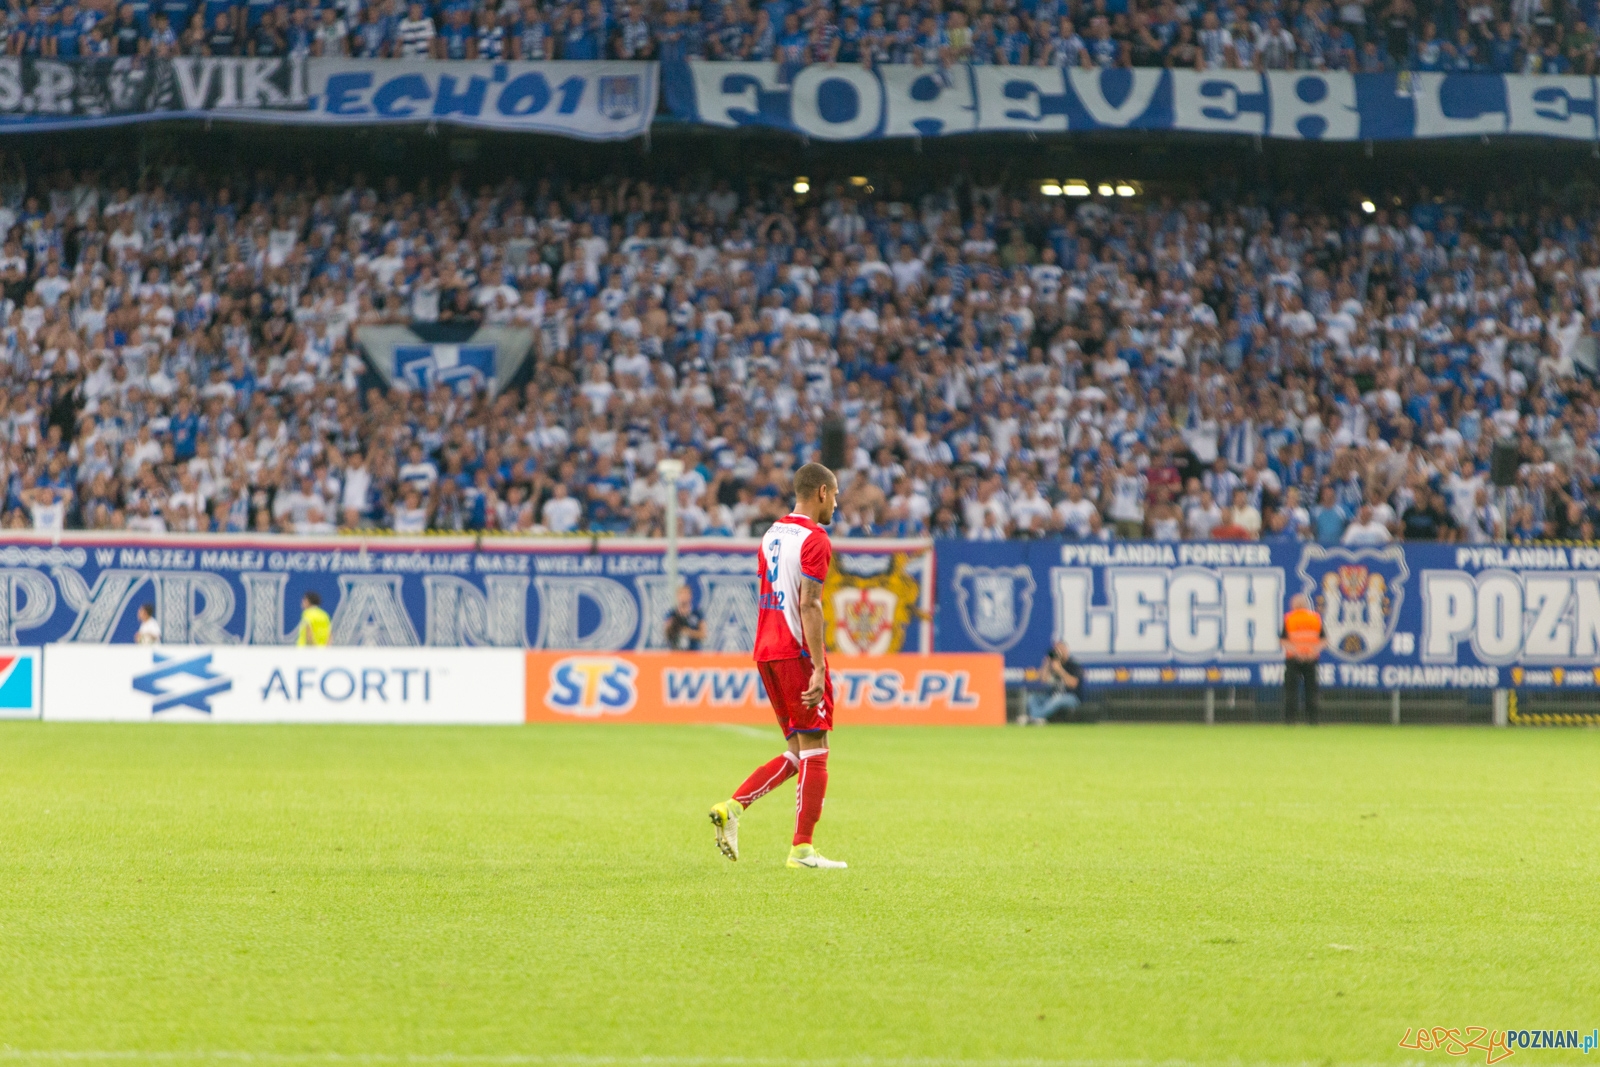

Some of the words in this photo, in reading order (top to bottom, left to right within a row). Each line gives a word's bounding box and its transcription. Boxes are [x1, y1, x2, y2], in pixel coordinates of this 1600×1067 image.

[307, 64, 587, 117] ECH'01
[690, 60, 1360, 141] FOREVER
[1412, 72, 1600, 140] LE
[95, 548, 116, 568] W
[119, 549, 196, 570] NASZEJ
[606, 555, 660, 576] LECH
[766, 539, 781, 583] 3
[1060, 543, 1177, 566] PYRLANDIA
[1178, 544, 1272, 566] FOREVER
[1455, 547, 1570, 569] PYRLANDIA
[1570, 547, 1600, 569] FO
[0, 567, 760, 650] PYRLANDIA
[1050, 565, 1286, 664] LECH
[262, 668, 431, 703] AFORTI
[545, 656, 638, 715] STS
[664, 669, 980, 708] WWTS.PL
[1339, 664, 1379, 686] THE
[1382, 664, 1500, 687] CHAMPIONS
